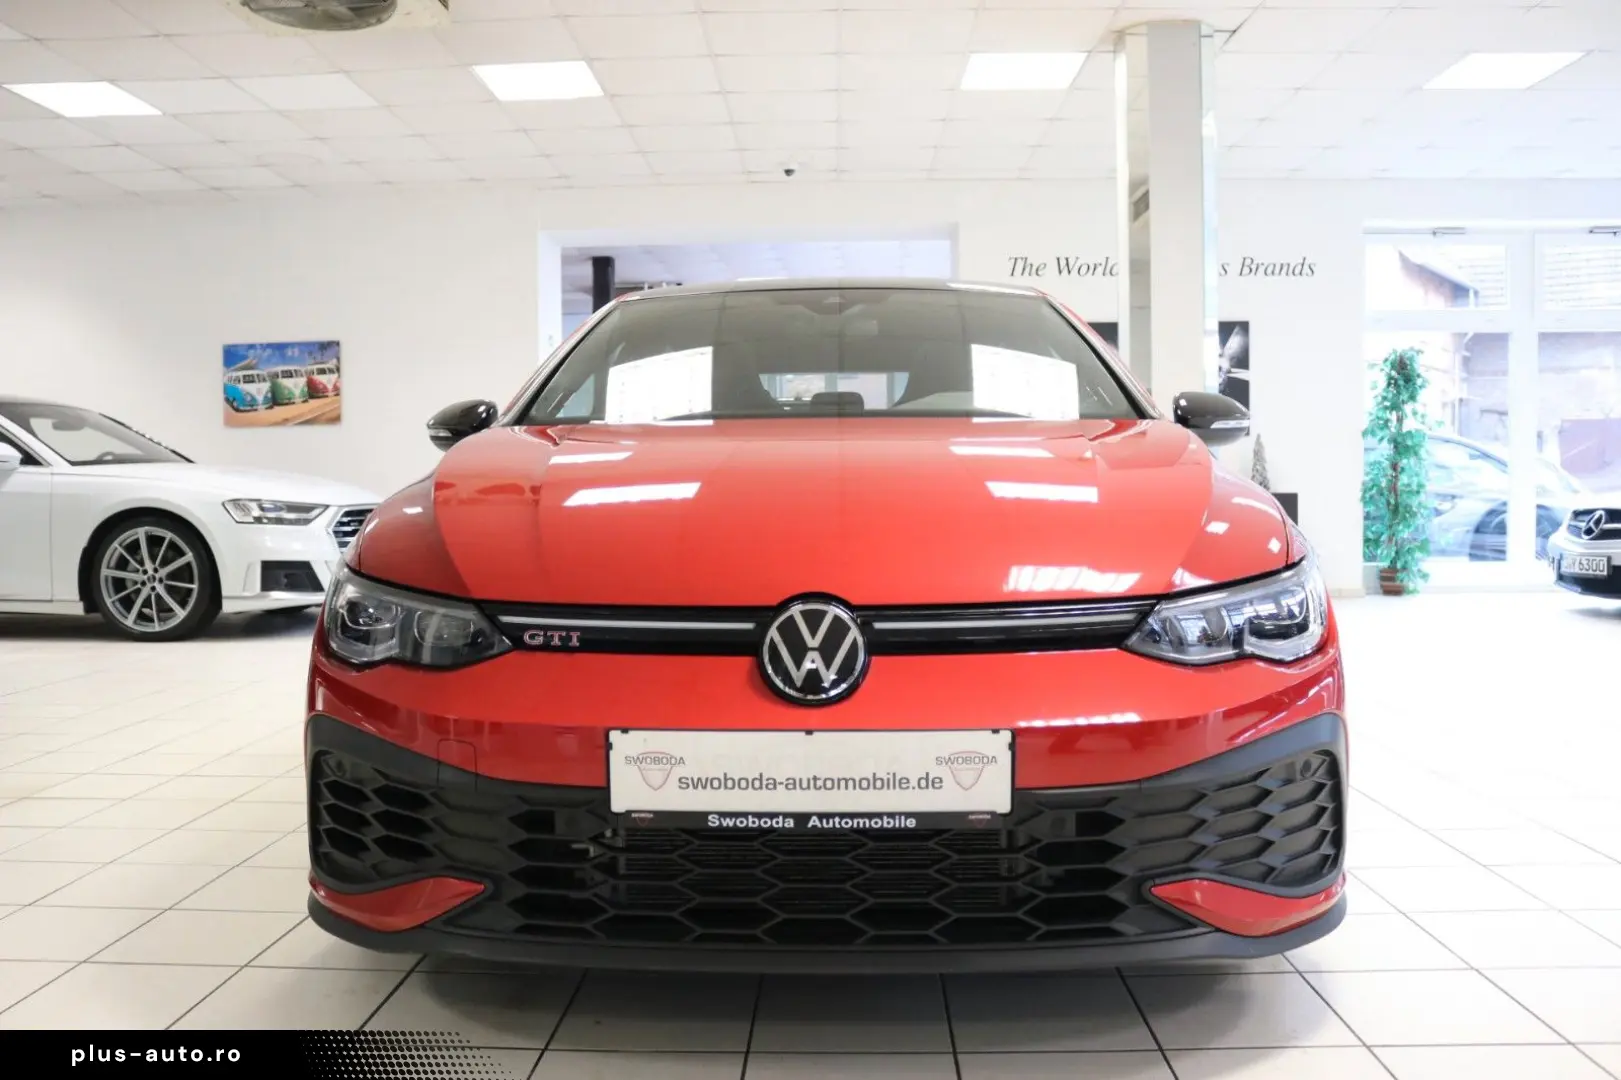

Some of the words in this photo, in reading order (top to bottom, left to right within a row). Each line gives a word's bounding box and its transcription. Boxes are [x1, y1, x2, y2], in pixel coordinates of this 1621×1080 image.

[1008, 256, 1047, 277] The
[1238, 256, 1316, 278] Brands
[1578, 558, 1606, 573] 6300
[523, 629, 581, 647] GTI
[624, 755, 686, 766] SWOBODA
[935, 755, 998, 766] SWOBODA
[677, 772, 944, 791] swoboda-automobile.de
[707, 813, 795, 828] Swoboda
[807, 815, 917, 829] Automobile
